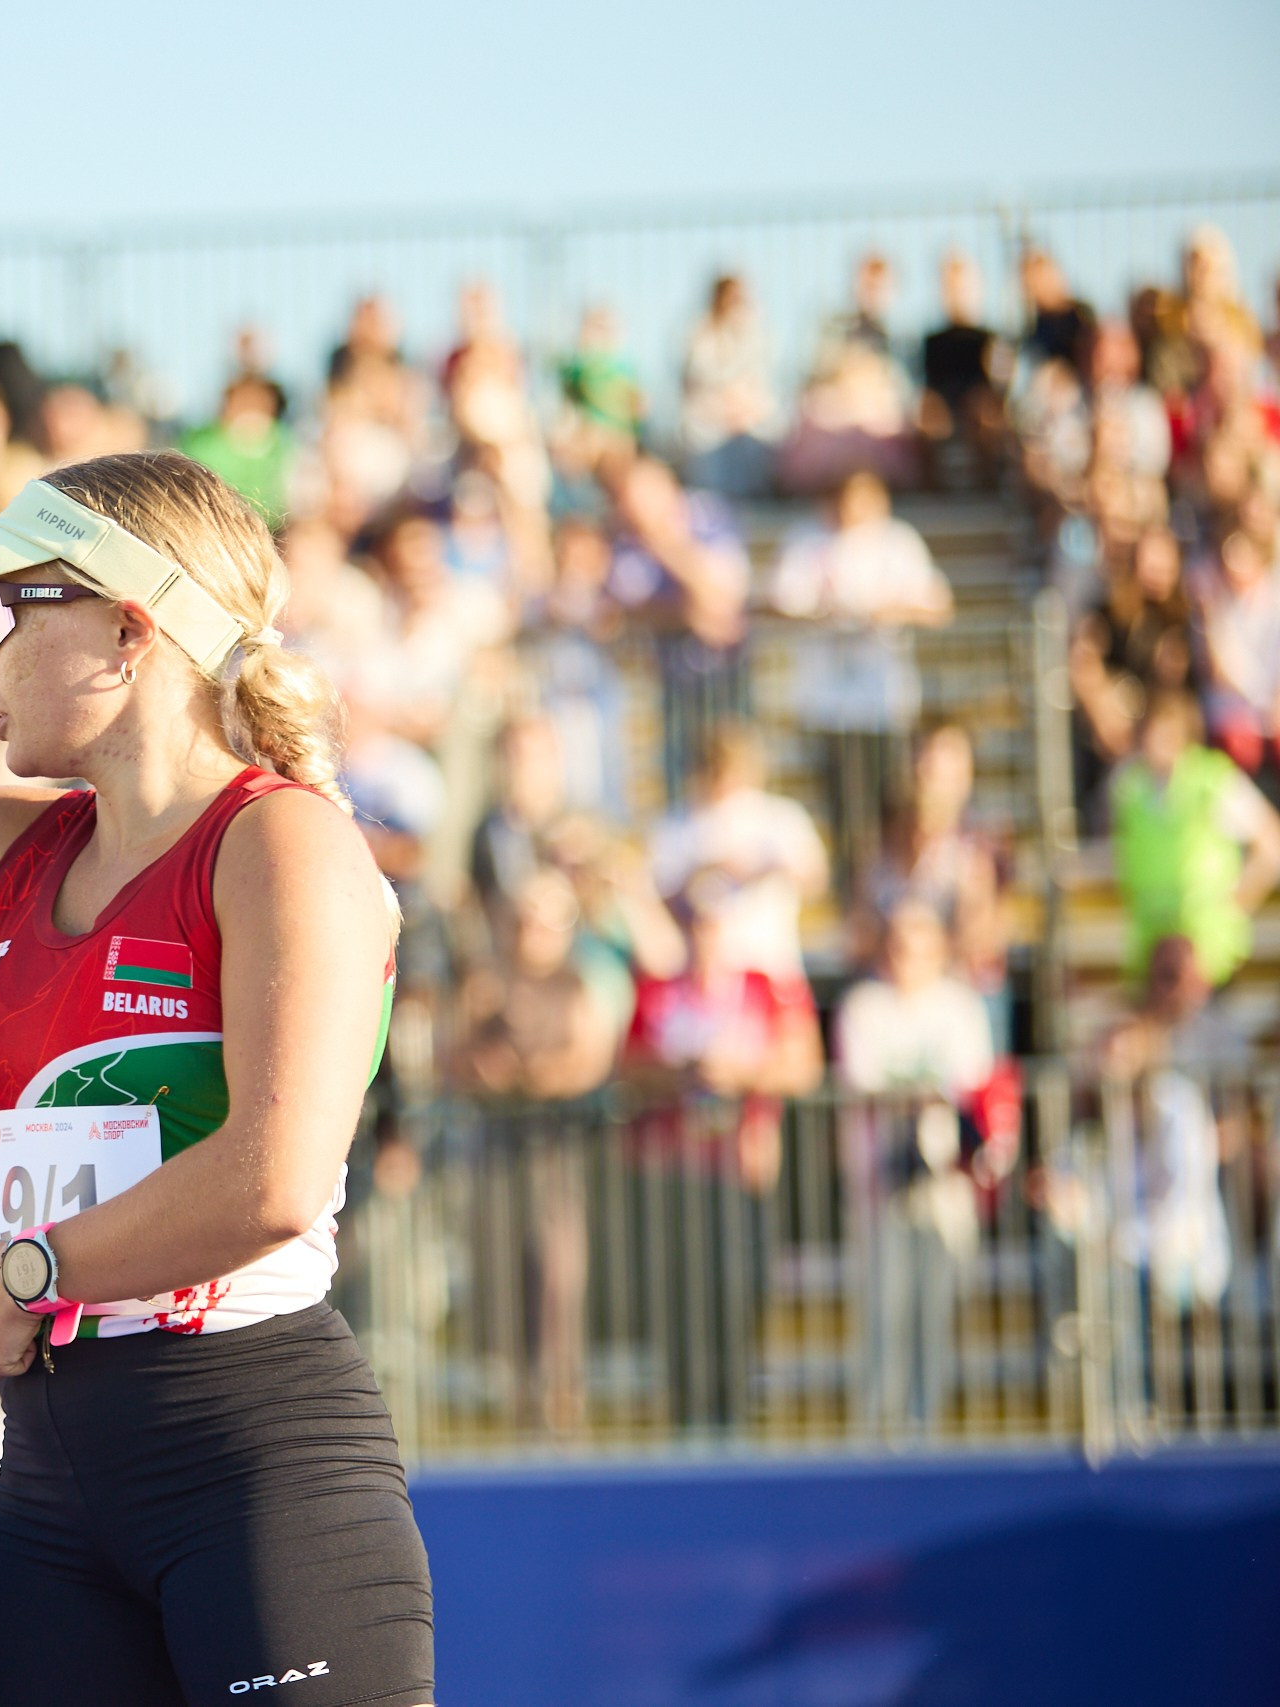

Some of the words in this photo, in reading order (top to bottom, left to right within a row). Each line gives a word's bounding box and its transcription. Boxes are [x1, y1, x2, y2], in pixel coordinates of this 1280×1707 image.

[36, 507, 86, 541] KIPRUN
[102, 990, 189, 1020] BELARUS
[25, 1122, 54, 1133] МОСКВА
[55, 1121, 73, 1132] 2024
[102, 1116, 150, 1130] МОСКОВСКИЙ
[102, 1130, 125, 1141] СПОРТ
[0, 1164, 98, 1240] 9/1
[228, 1659, 330, 1695] ORAZ
